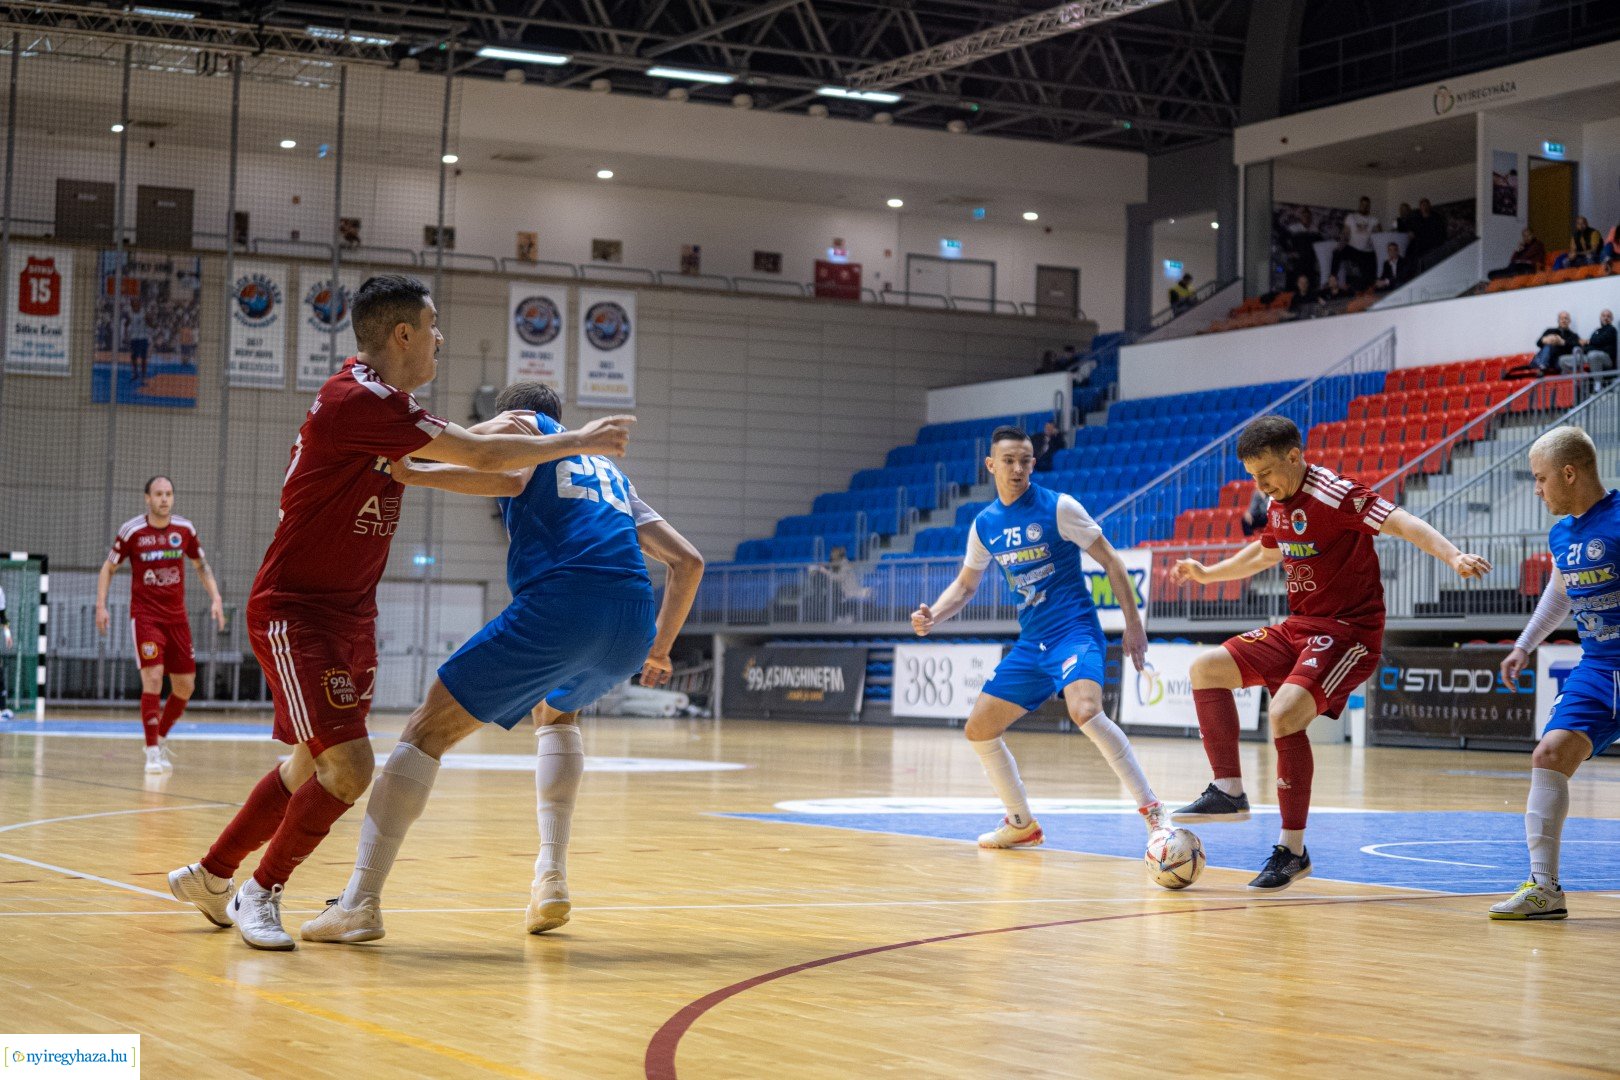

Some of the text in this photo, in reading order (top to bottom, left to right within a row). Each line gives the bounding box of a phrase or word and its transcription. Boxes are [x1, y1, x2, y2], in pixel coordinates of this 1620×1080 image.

[28, 276, 52, 304] 15
[555, 454, 634, 518] 20
[1003, 526, 1022, 548] 75
[1566, 542, 1583, 566] 21
[905, 656, 954, 707] 383
[1506, 708, 1532, 720] KFT
